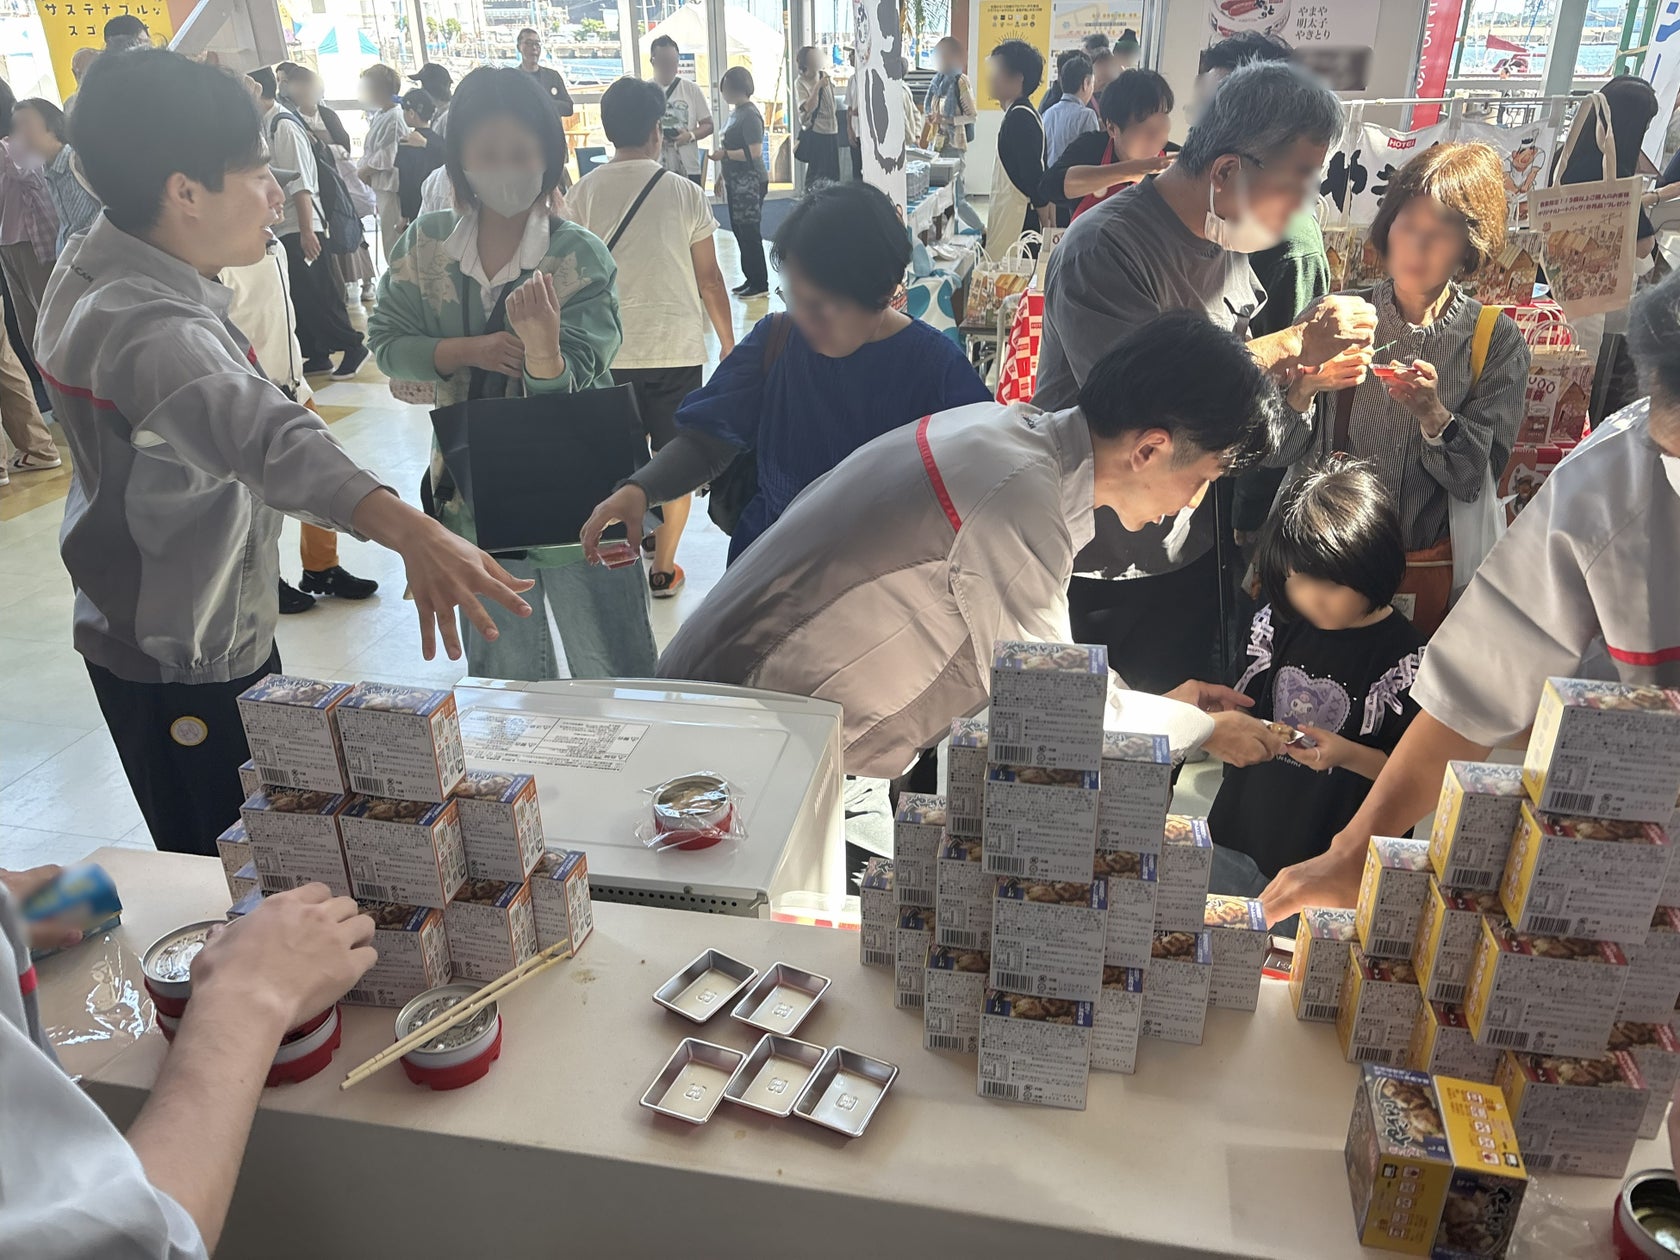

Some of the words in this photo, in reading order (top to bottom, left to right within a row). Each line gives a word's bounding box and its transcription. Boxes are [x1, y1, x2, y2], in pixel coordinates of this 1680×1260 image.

[1298, 6, 1328, 17] やまや
[1296, 18, 1328, 29] 明太子
[1295, 30, 1331, 41] やきとり
